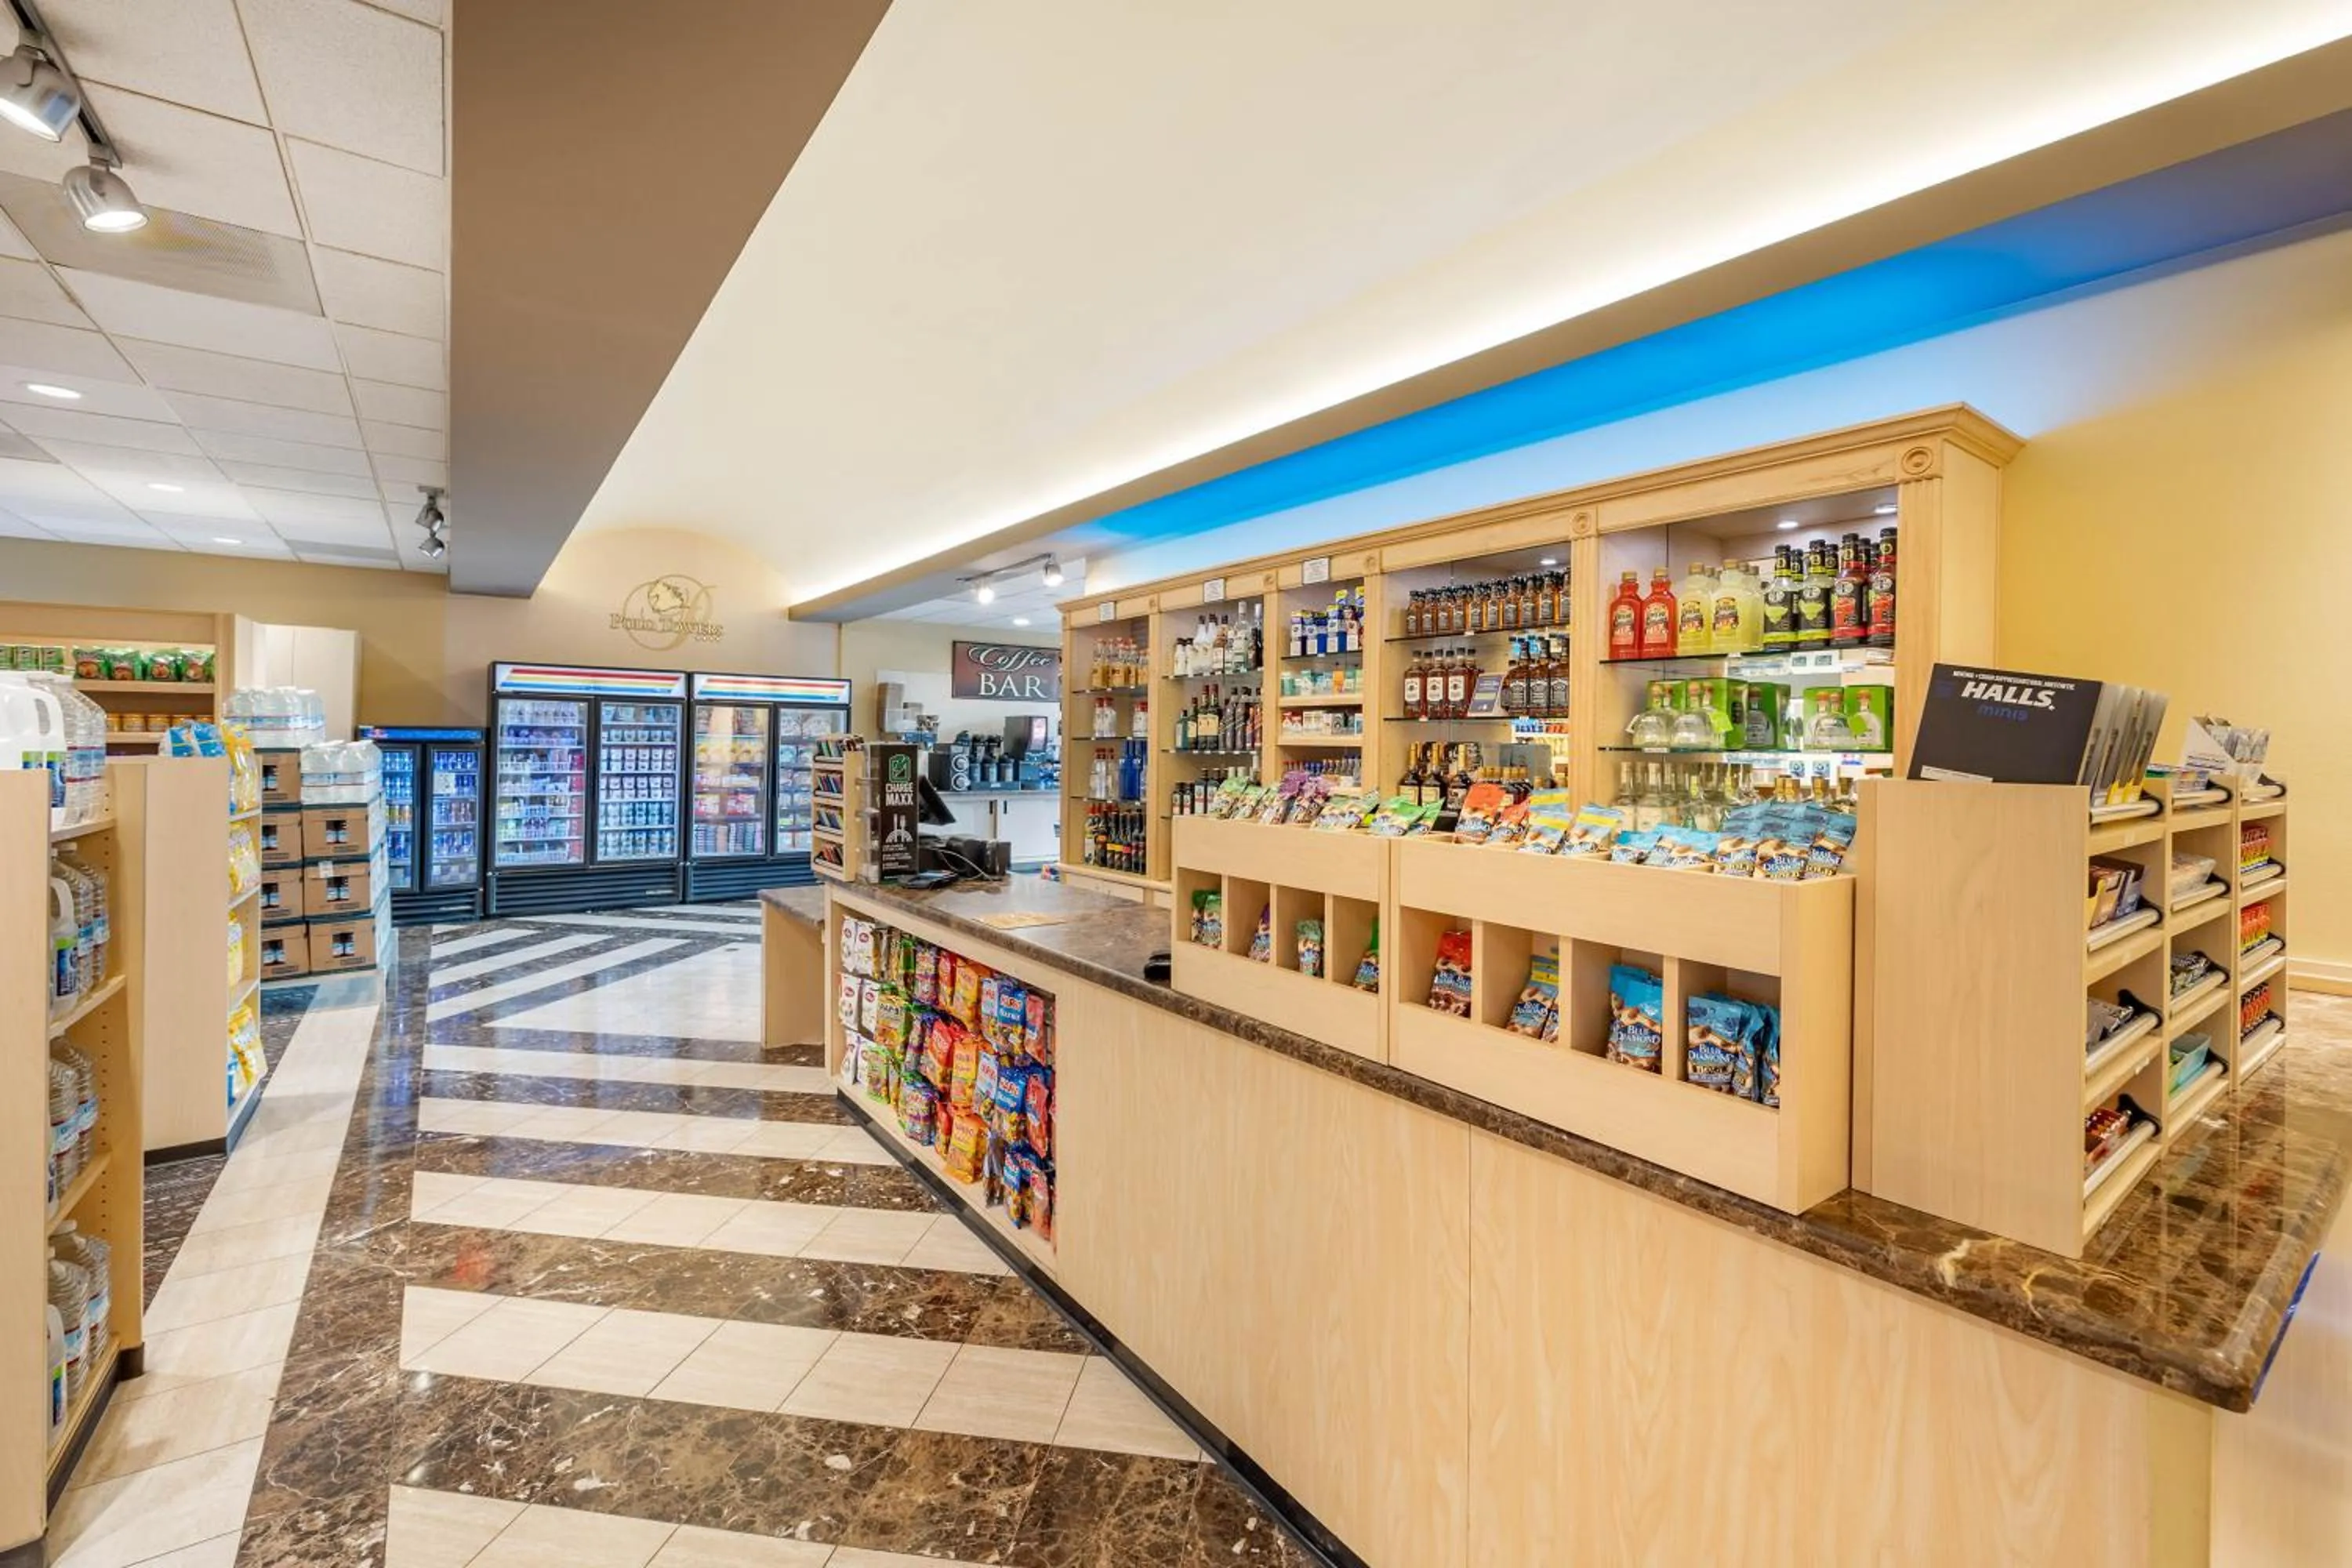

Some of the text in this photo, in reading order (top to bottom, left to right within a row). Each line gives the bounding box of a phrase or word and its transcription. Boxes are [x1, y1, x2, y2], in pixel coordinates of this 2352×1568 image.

[968, 646, 1052, 672] Coffee
[978, 672, 1048, 699] BAR
[885, 793, 913, 807] MAXX
